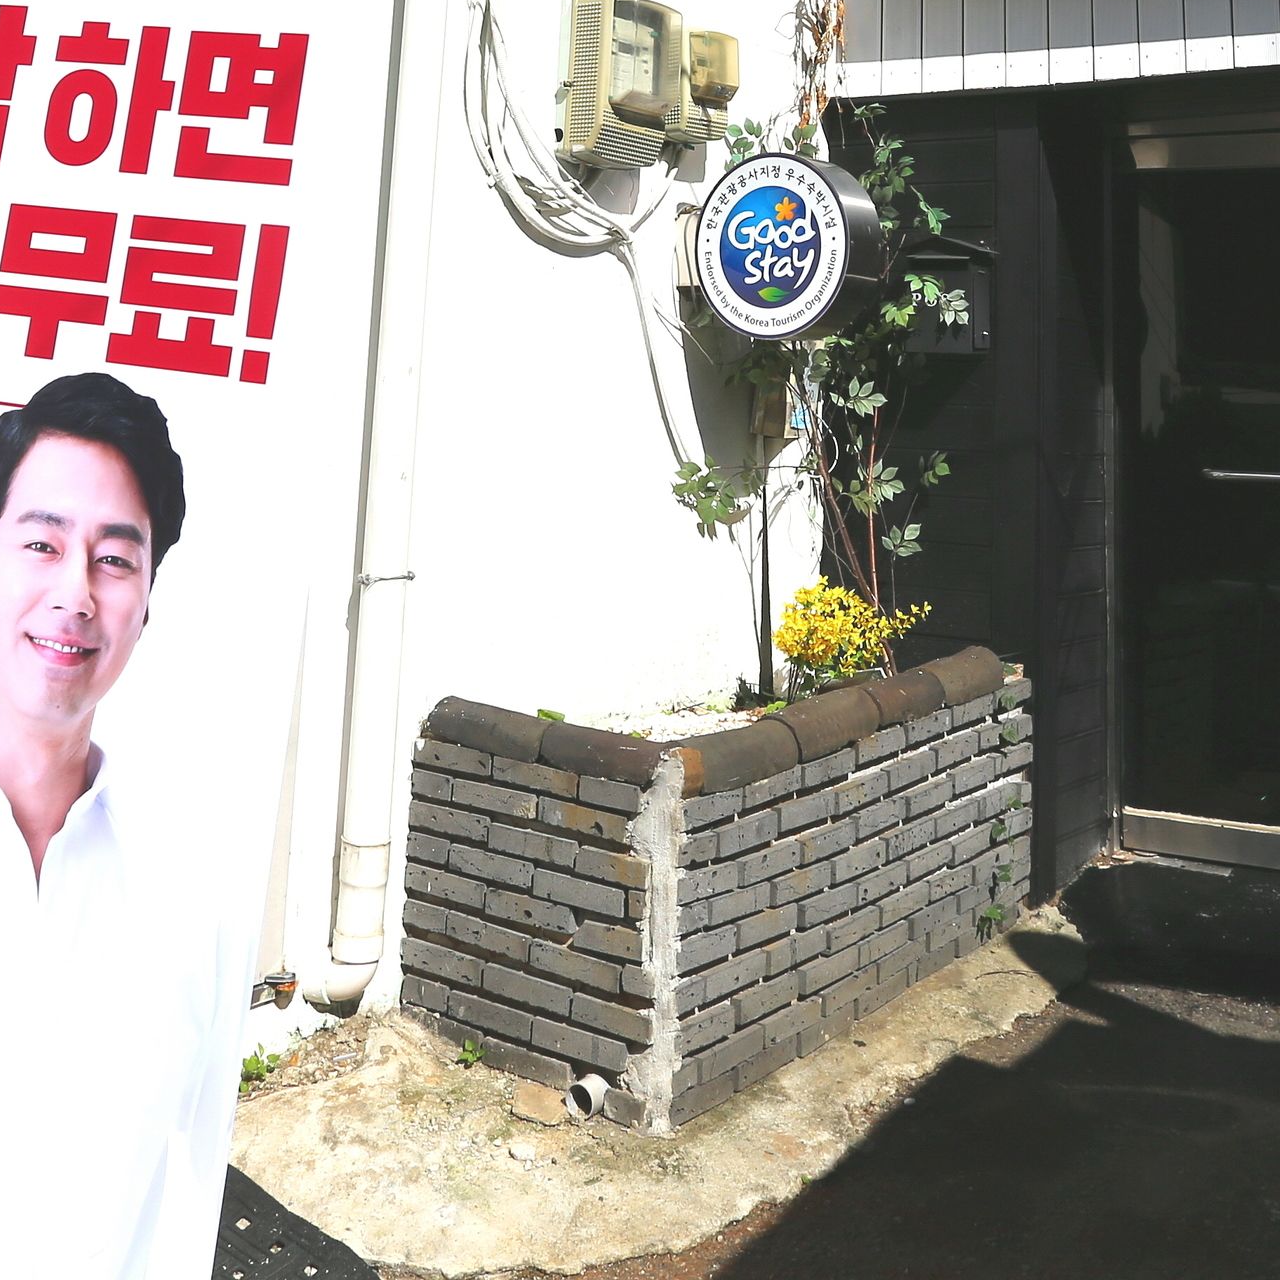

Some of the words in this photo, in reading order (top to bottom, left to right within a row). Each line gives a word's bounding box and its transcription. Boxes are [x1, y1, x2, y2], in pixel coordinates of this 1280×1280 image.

[705, 164, 781, 230] 한국관광공사지정
[785, 167, 838, 230] 우수숙박시설
[727, 208, 817, 250] Good
[704, 251, 724, 297] Endorsed
[720, 294, 731, 309] by
[730, 305, 744, 320] the
[744, 313, 769, 328] Korea
[771, 308, 806, 327] Tourism
[804, 249, 838, 311] Organization
